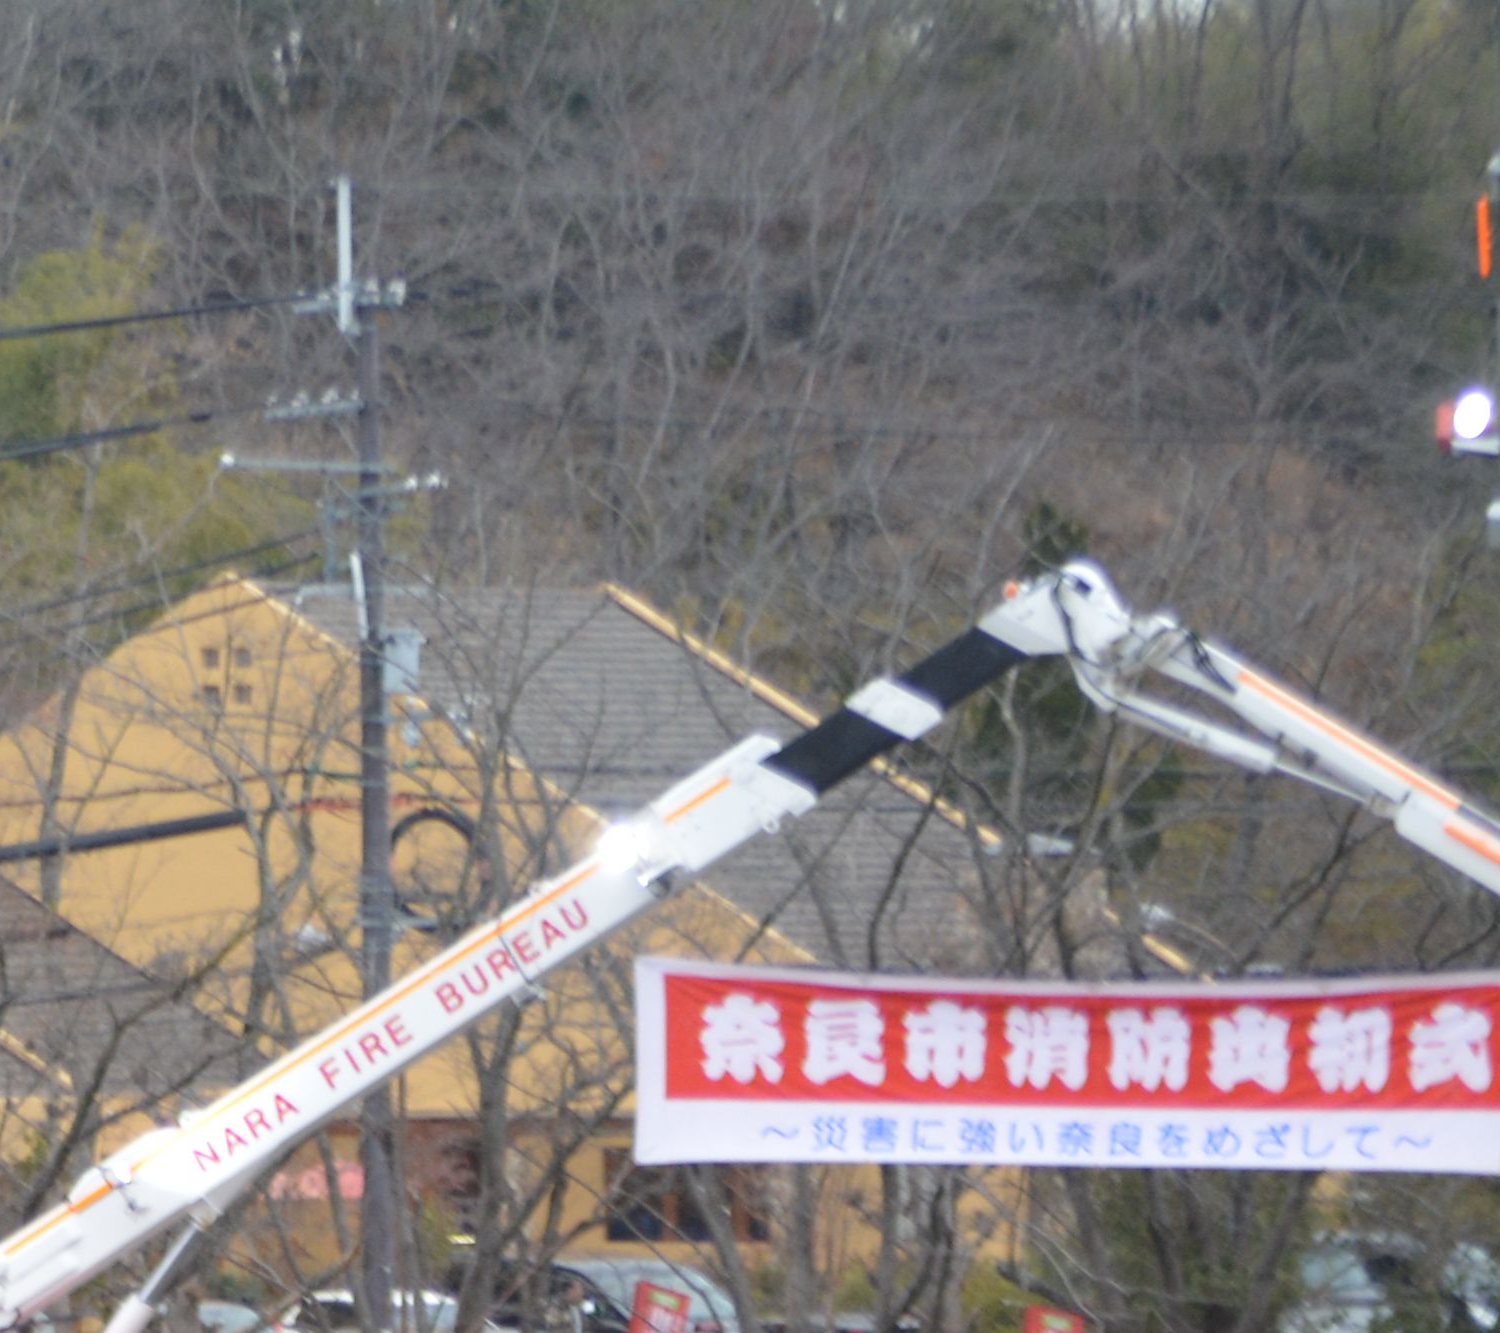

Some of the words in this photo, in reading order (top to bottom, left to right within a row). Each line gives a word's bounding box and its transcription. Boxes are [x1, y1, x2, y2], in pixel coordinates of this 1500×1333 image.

[192, 1093, 300, 1172] NARA
[317, 1014, 414, 1089] FIRE
[433, 899, 590, 1014] BUREAU
[699, 993, 1492, 1093] 奈良市消防出初式
